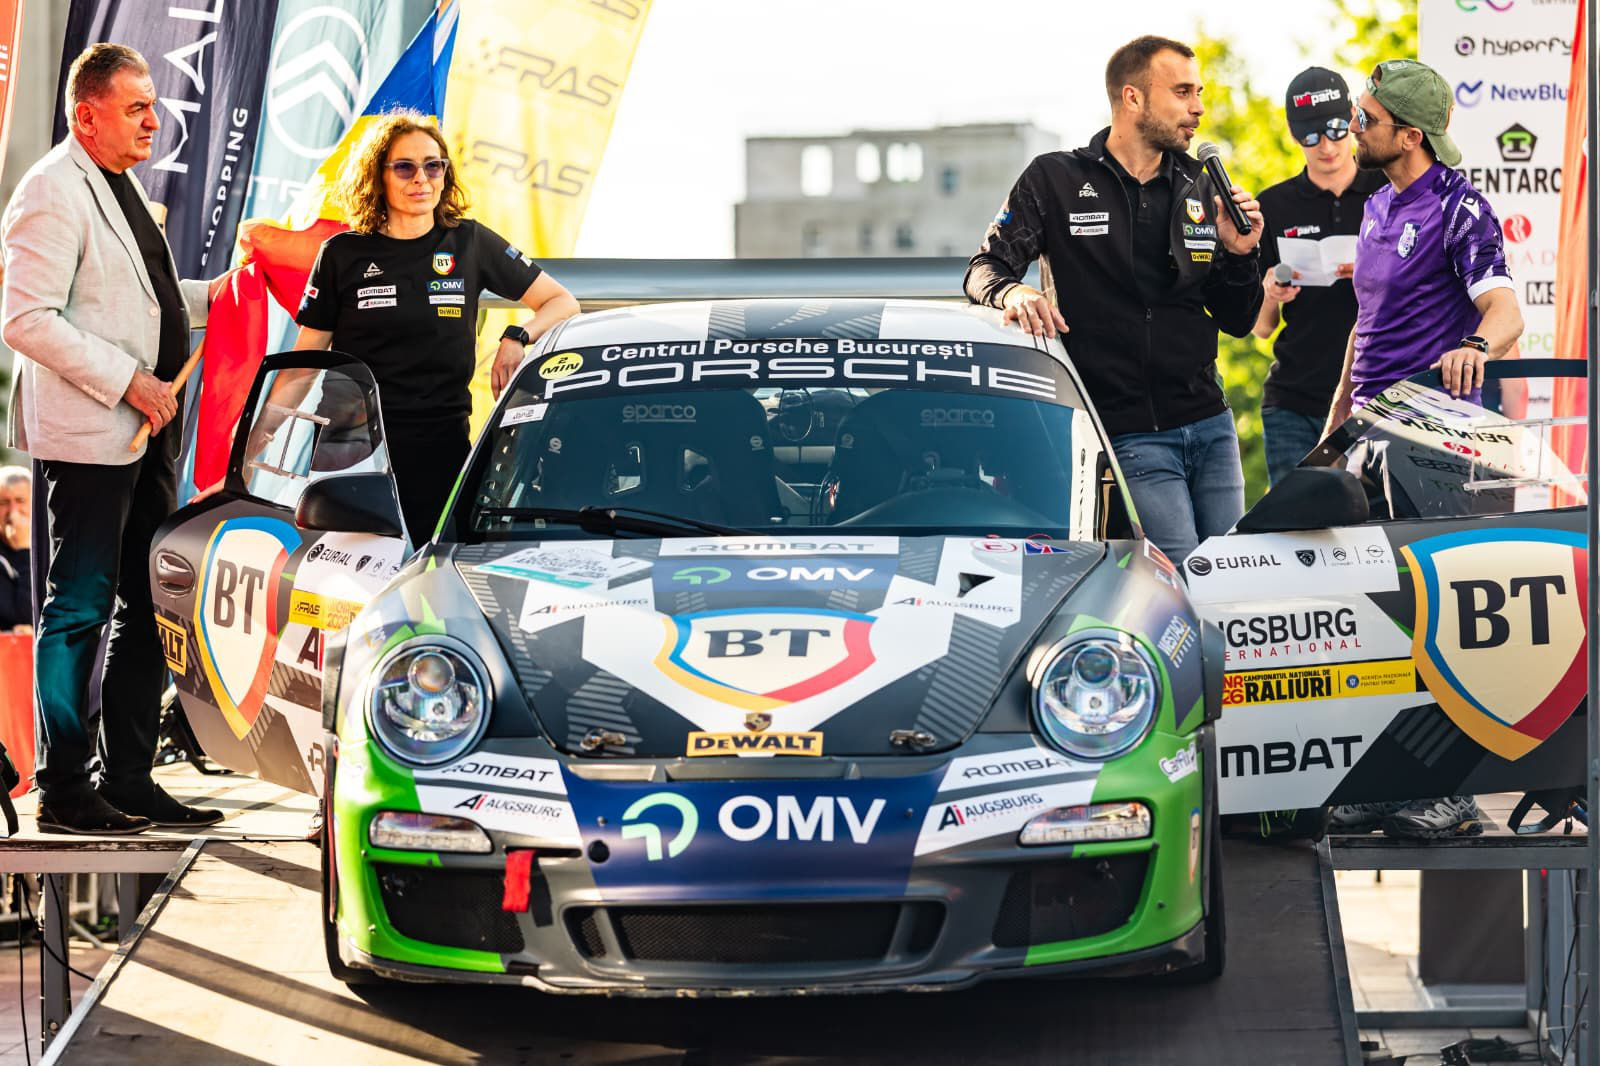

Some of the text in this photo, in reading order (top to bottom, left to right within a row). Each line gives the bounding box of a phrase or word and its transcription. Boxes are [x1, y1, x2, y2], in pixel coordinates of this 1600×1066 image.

[1194, 227, 1213, 235] OMV
[436, 258, 450, 267] BT
[442, 281, 462, 289] OMV
[558, 356, 568, 364] 2
[601, 339, 974, 362] Centrul Porsche București
[542, 361, 581, 375] MIN
[543, 357, 1057, 400] PORSCHE
[622, 403, 697, 421] sparco
[920, 408, 995, 426] sparco
[684, 542, 875, 553] ROMBAT
[746, 567, 875, 581] OMV
[213, 558, 265, 635] BT
[1449, 574, 1567, 650] BT
[1219, 608, 1358, 648] GSBURG
[158, 627, 185, 662] ALT
[704, 627, 831, 659] BT
[1245, 676, 1332, 703] RALIURI
[487, 799, 563, 819] AUGSBURG
[965, 793, 1044, 818] AUGSBURG
[717, 795, 887, 844] OMV
